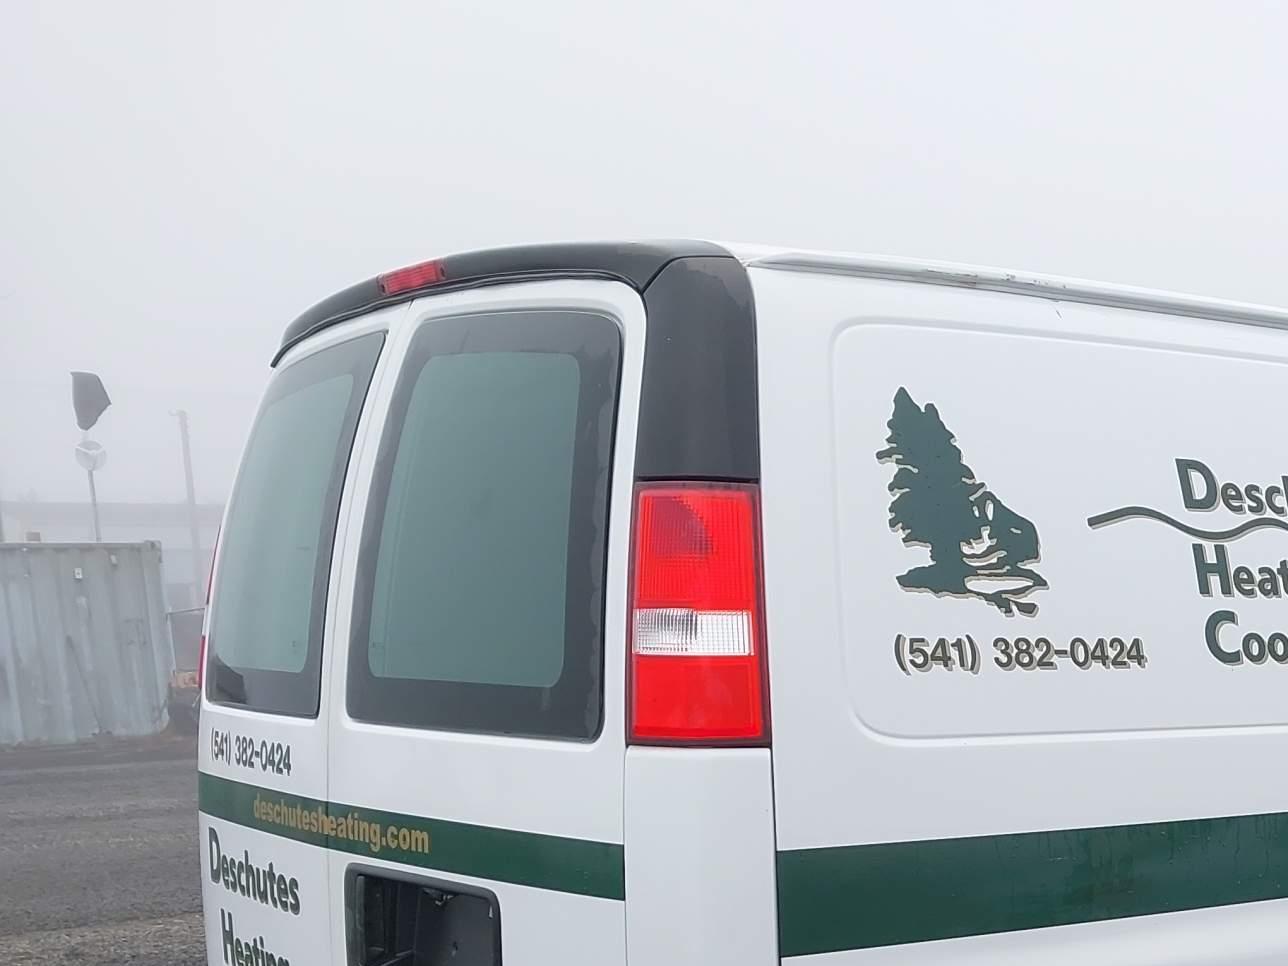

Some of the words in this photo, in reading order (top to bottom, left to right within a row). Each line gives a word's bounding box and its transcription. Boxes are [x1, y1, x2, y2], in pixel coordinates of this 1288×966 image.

[893, 634, 980, 675] (541)
[992, 637, 1147, 671] 382-0424
[210, 727, 232, 764] (541)
[234, 736, 292, 776] 382-0424
[253, 795, 429, 853] deschutesheating.com
[208, 827, 301, 916] Deschutes
